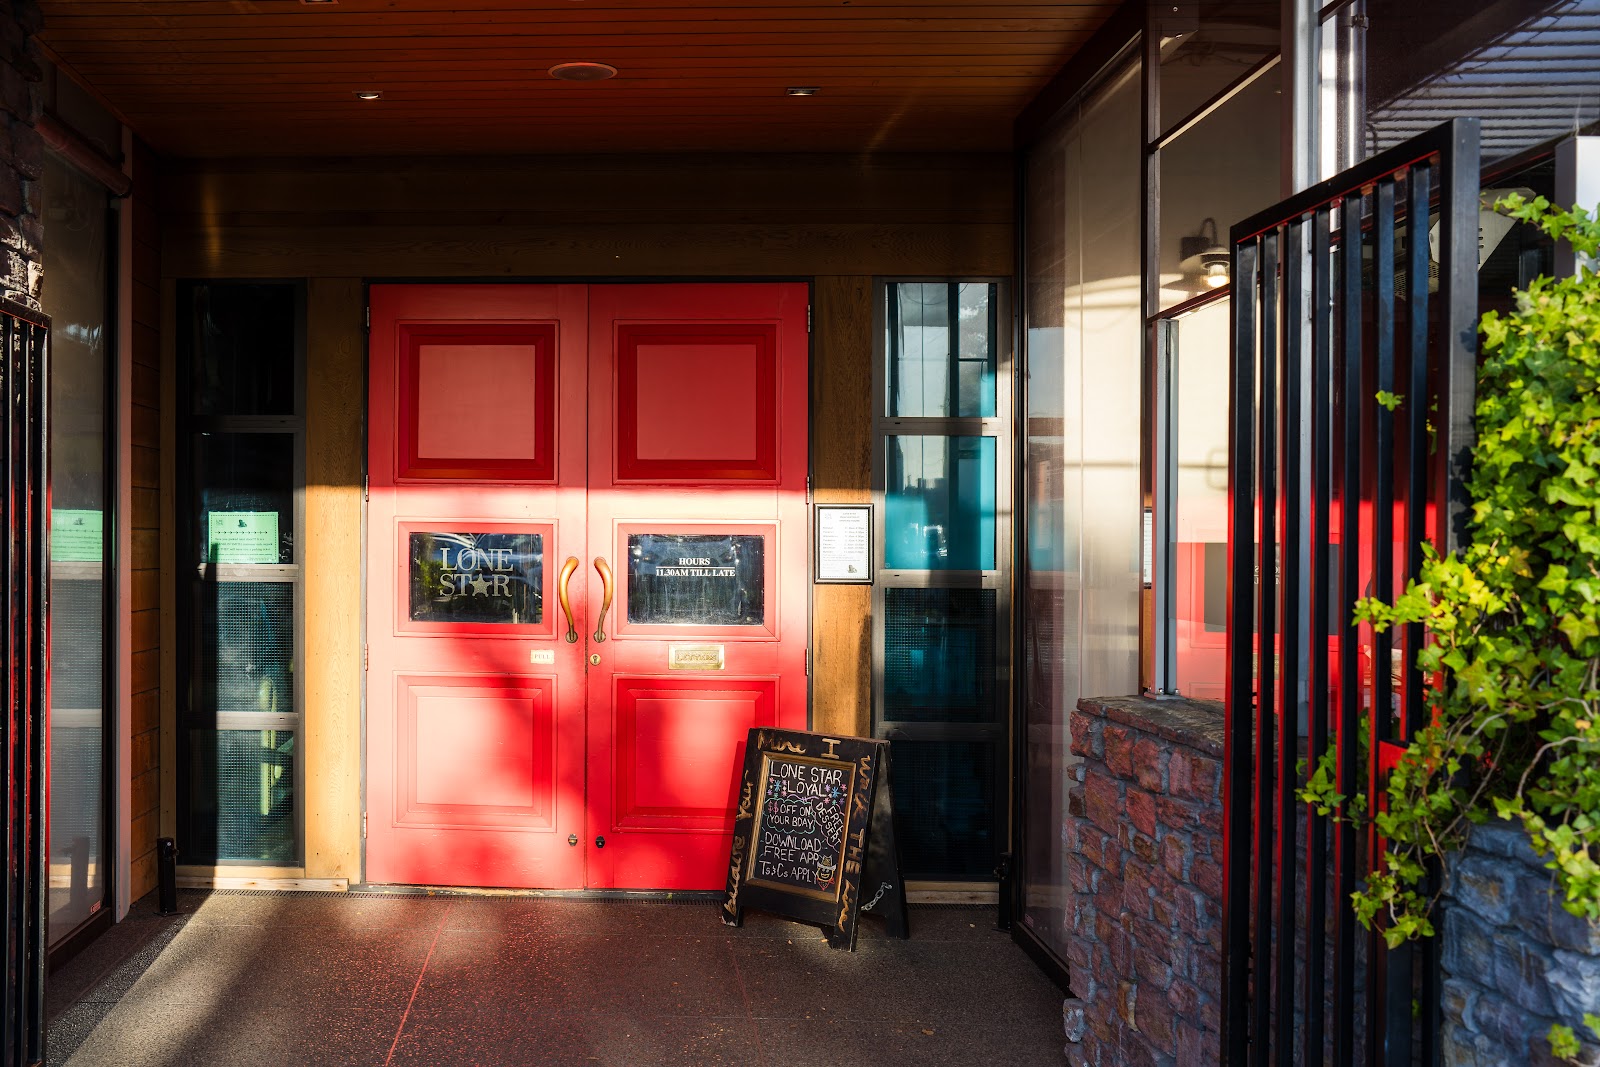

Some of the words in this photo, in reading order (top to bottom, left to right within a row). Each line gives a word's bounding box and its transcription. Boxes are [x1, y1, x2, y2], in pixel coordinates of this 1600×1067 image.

[440, 547, 514, 572] LONE
[678, 557, 711, 566] HOURS
[656, 569, 689, 577] 11.30AM
[690, 569, 711, 577] TILL
[712, 569, 736, 577] LATE
[821, 737, 841, 760] I
[770, 763, 806, 781] LONE
[811, 767, 842, 786] STAR
[787, 781, 827, 798] LOYAL
[780, 804, 797, 815] OFF
[800, 806, 811, 817] ON
[827, 805, 844, 836] FREE
[769, 814, 790, 825] YOUR
[792, 816, 814, 830] BDAY
[815, 802, 842, 846] DESSERT
[765, 831, 822, 853] DOWNLOAD
[845, 828, 865, 875] THE
[764, 845, 797, 862] FREE
[799, 852, 819, 865] APP
[790, 866, 817, 885] APPLY
